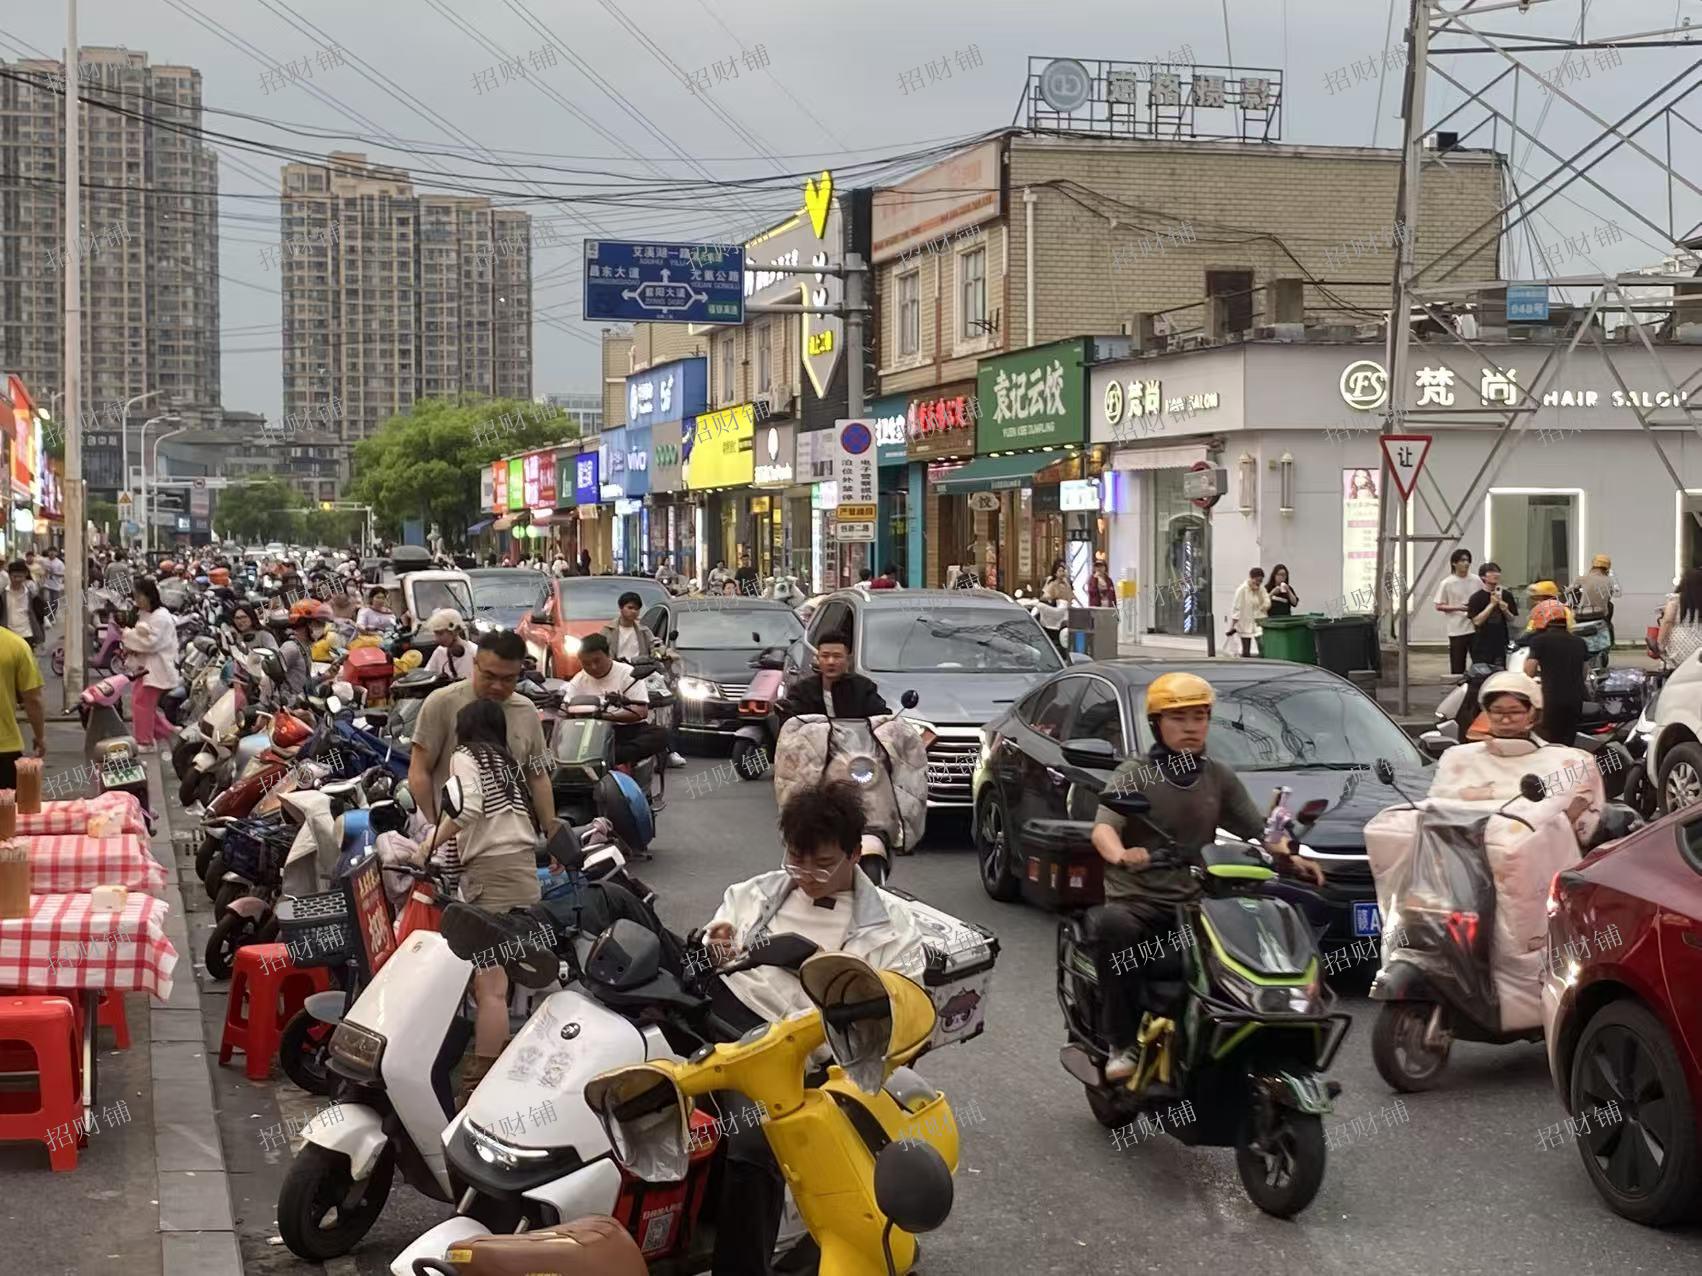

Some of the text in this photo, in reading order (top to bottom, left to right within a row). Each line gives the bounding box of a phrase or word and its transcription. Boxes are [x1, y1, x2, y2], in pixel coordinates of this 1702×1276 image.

[992, 359, 1066, 424] 袁记云饺
[1128, 380, 1161, 417] 梵尚
[1416, 366, 1518, 406] 梵尚
[1543, 390, 1598, 407] HAIR
[1398, 447, 1413, 467] 让
